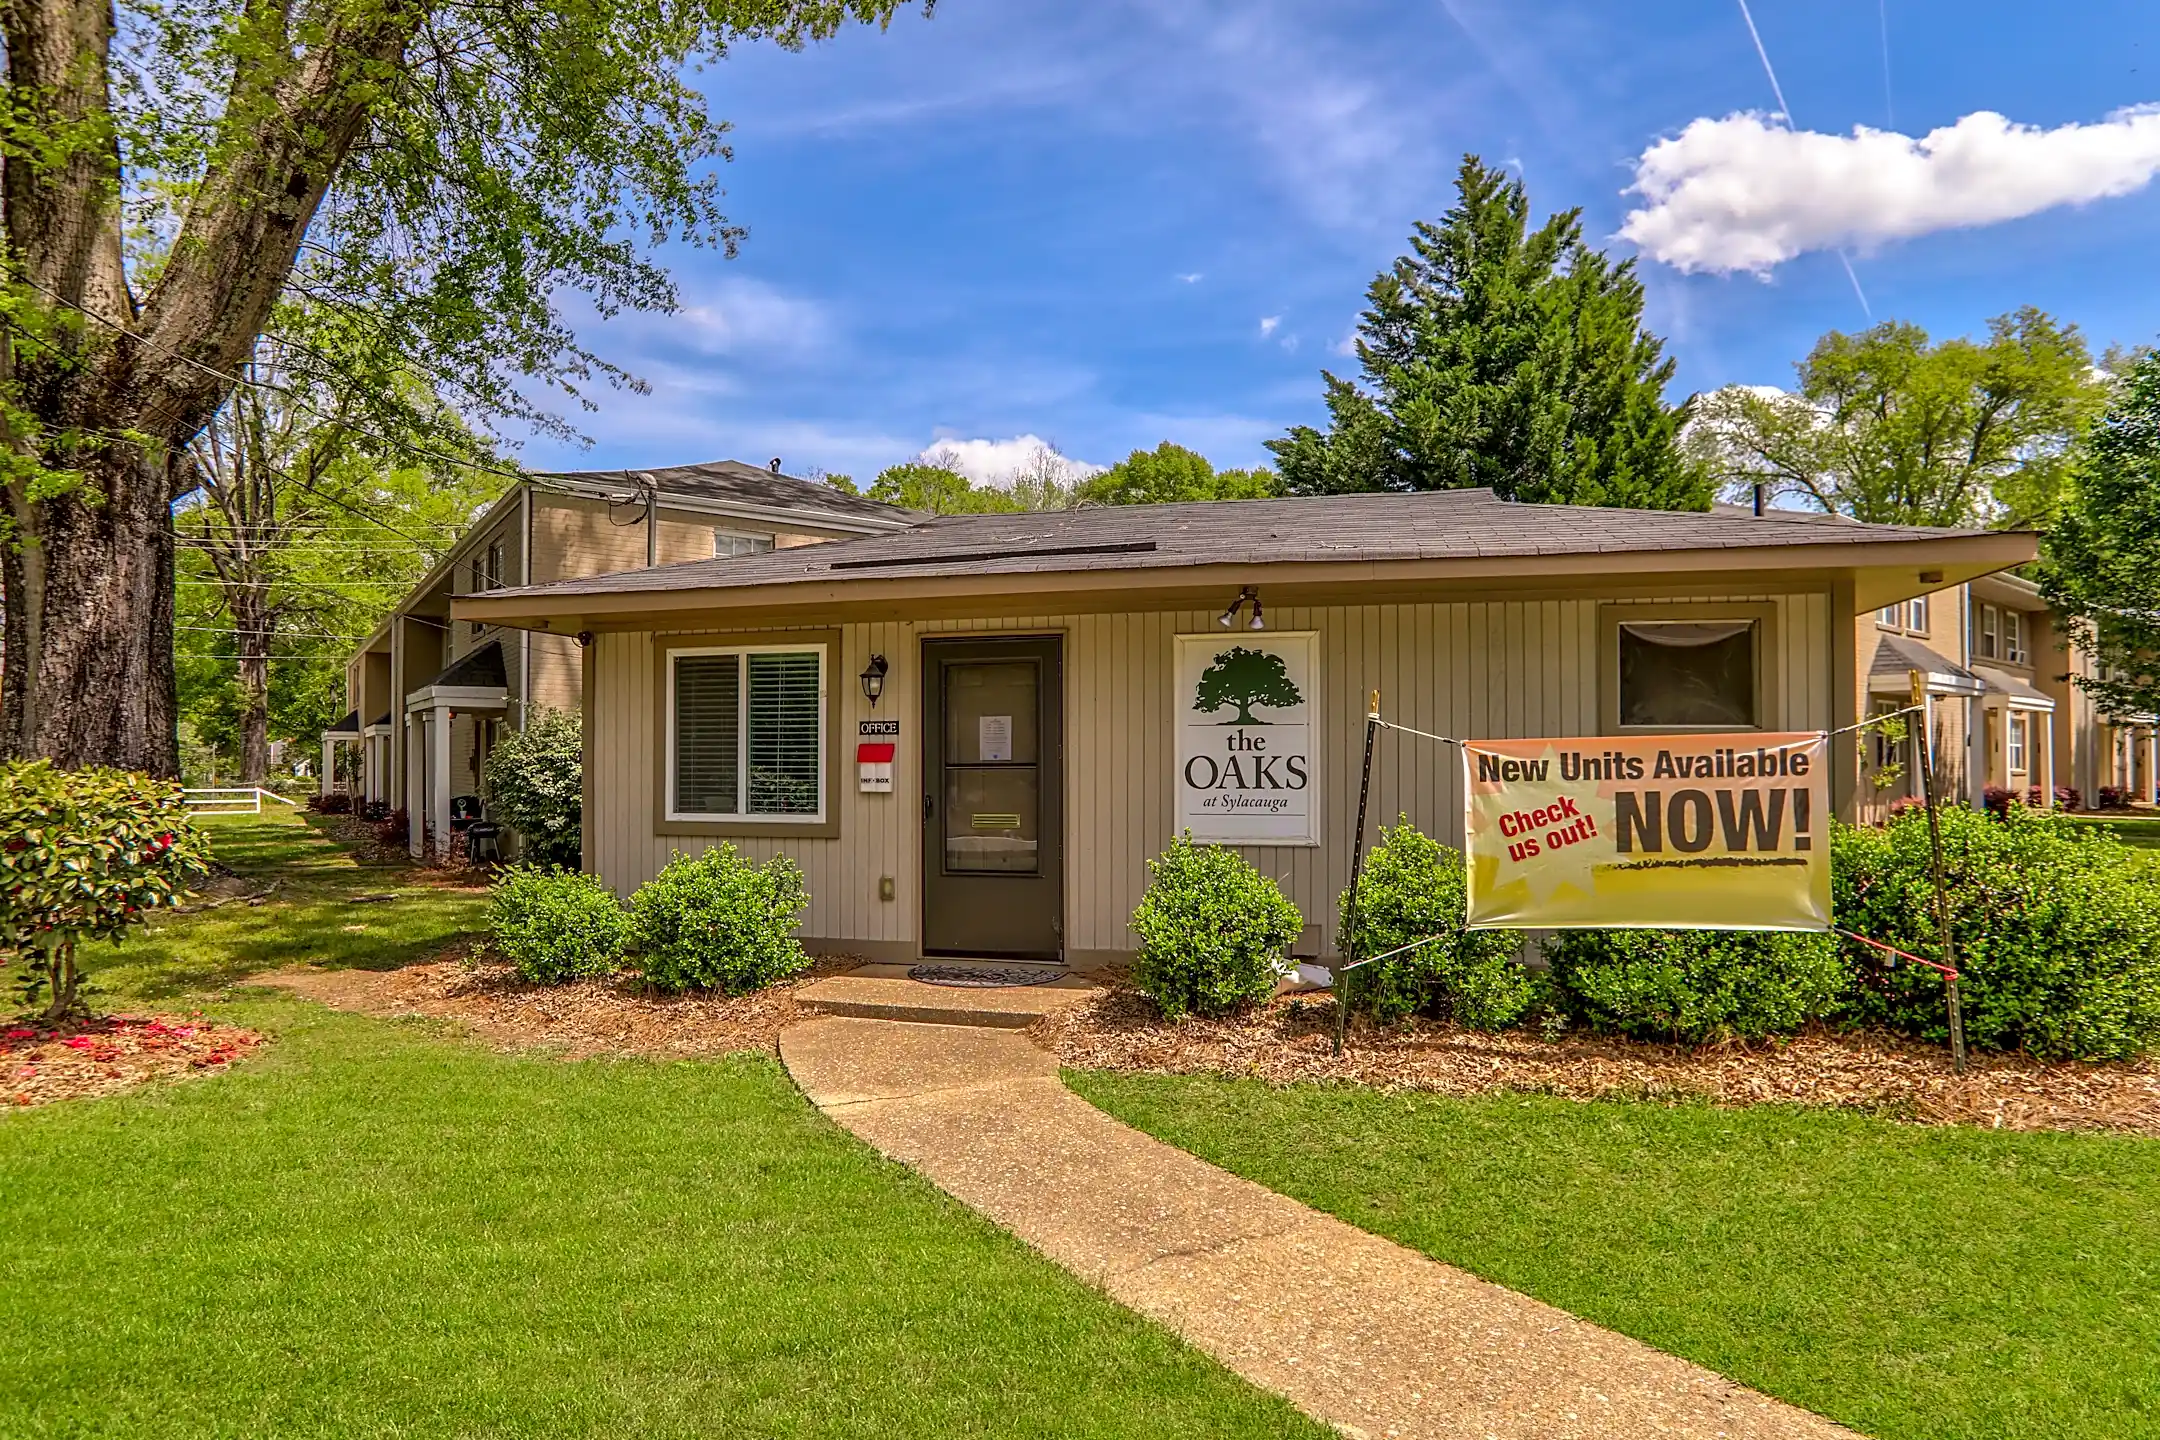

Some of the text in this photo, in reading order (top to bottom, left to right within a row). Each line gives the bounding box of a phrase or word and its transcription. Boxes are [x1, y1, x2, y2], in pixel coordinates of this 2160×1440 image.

[861, 723, 897, 733] OFFICE
[1226, 729, 1267, 752] the
[1185, 755, 1308, 790] OAKS
[1479, 748, 1809, 782] New Units Available
[1203, 794, 1288, 813] at Sylacauga
[1499, 796, 1582, 838] Check
[1616, 788, 1811, 853] NOW!
[1507, 813, 1597, 862] us out!
